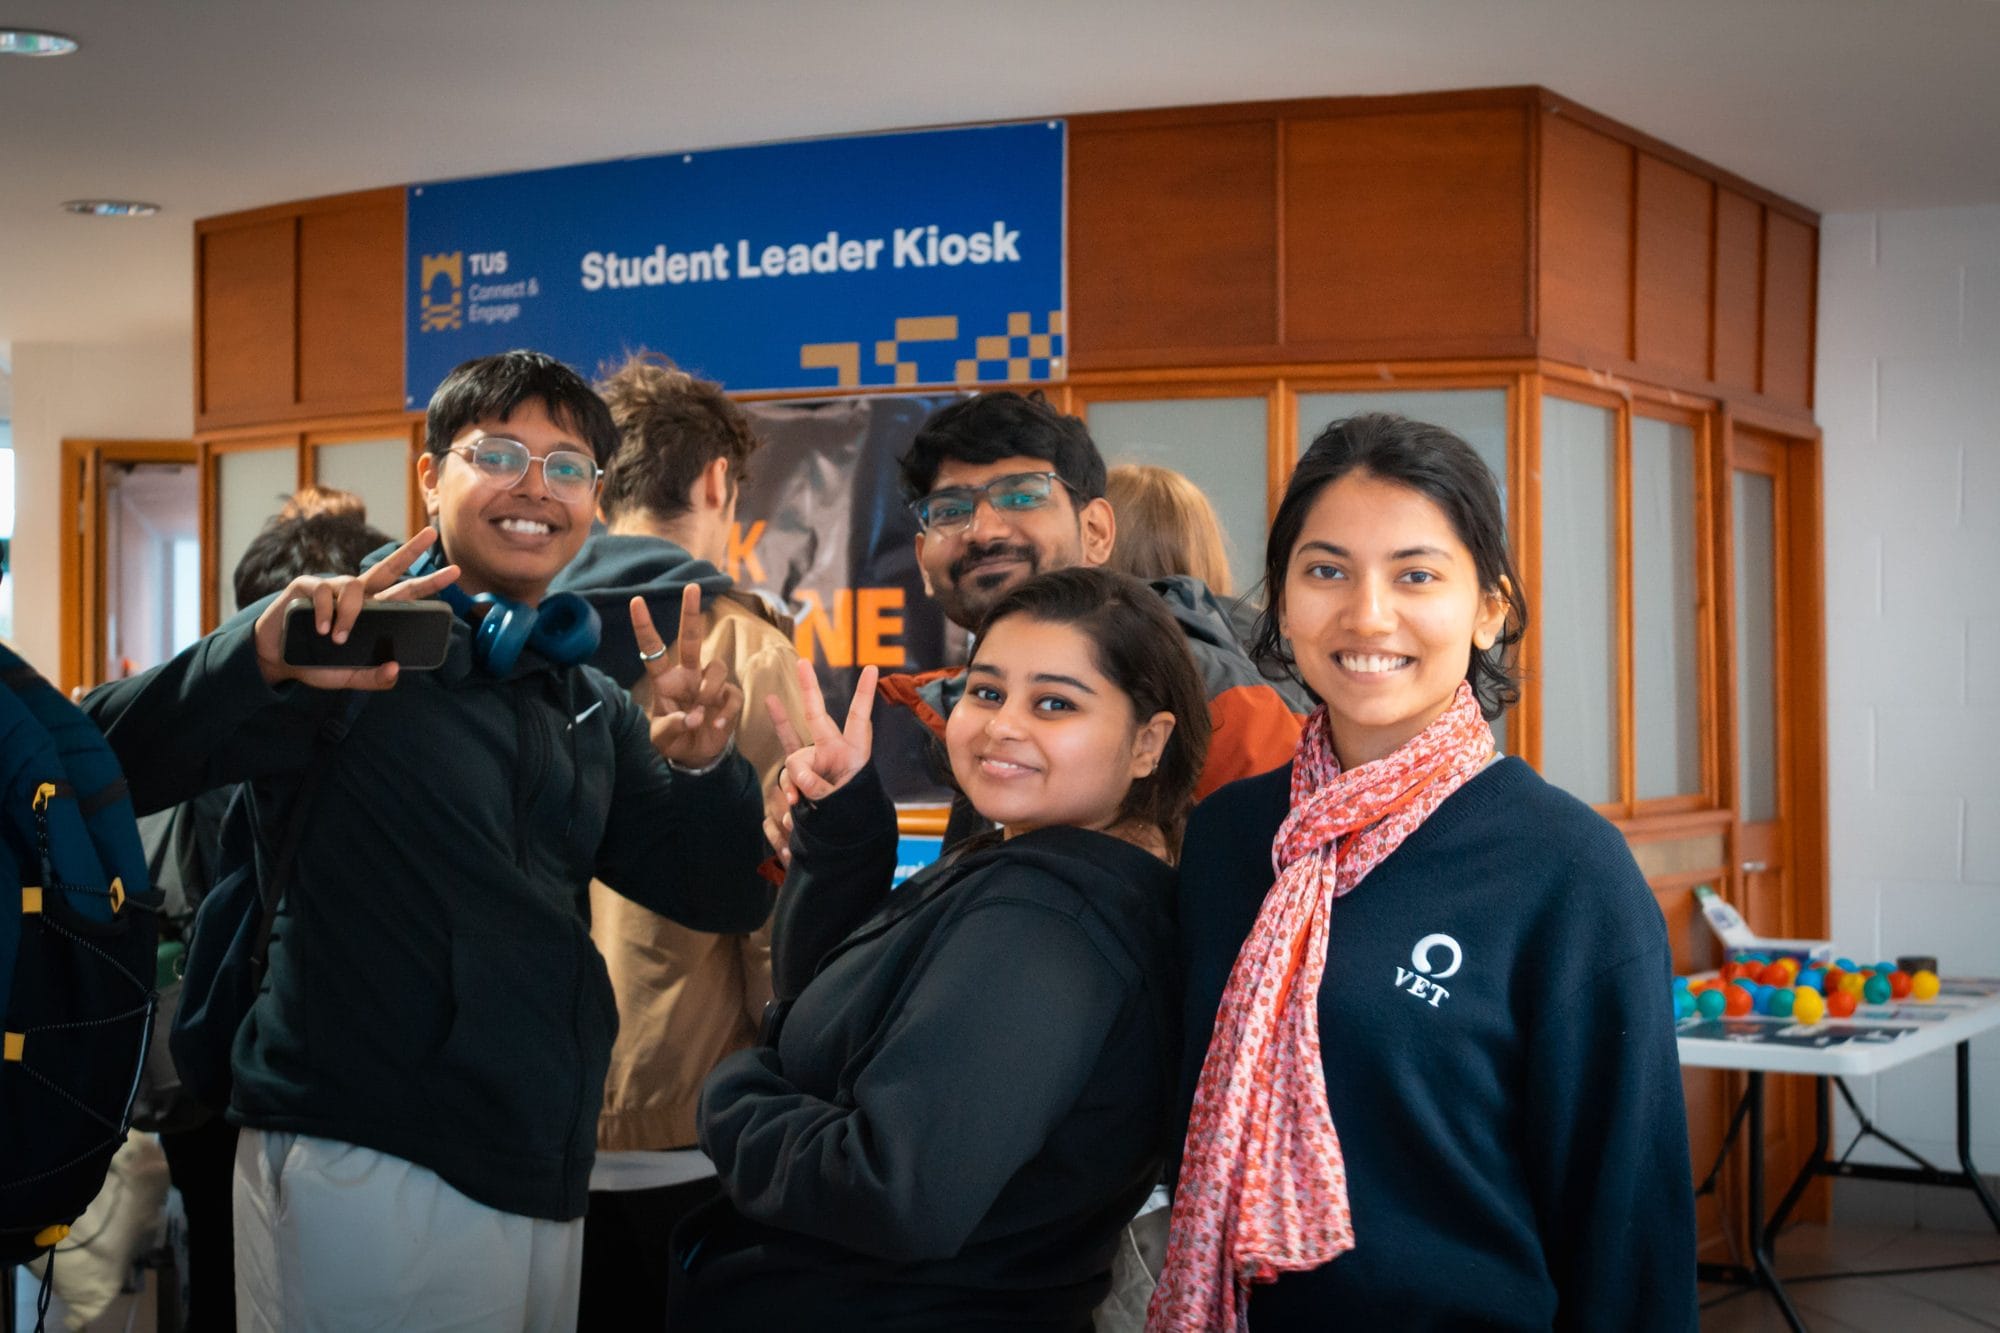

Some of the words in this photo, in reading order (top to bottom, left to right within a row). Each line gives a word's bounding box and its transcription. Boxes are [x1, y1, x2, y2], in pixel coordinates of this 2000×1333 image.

[468, 251, 507, 276] TUS
[581, 244, 729, 291] Student
[737, 231, 884, 278] Leader
[893, 221, 1021, 268] Kiosk
[468, 282, 526, 302] Connect
[528, 278, 539, 298] &
[468, 303, 521, 325] Engage
[1395, 967, 1450, 1008] VET
